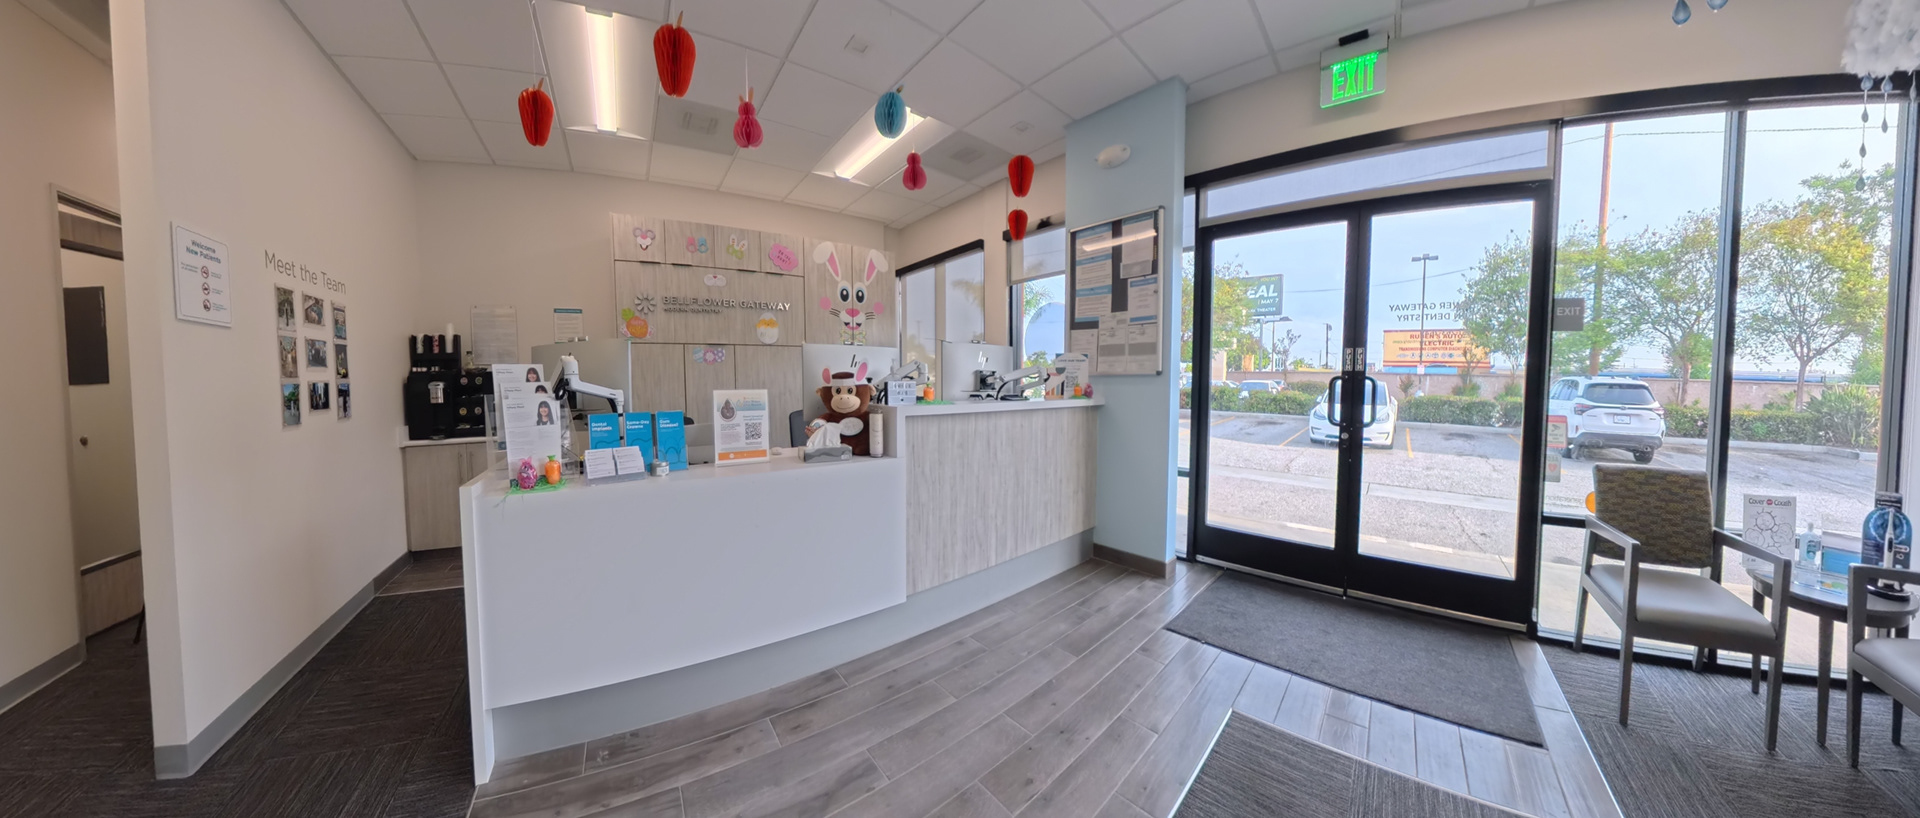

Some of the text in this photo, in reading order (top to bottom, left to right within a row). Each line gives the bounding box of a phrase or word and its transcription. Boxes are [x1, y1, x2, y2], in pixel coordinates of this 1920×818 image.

[1331, 51, 1379, 100] EXIT
[186, 246, 222, 264] New Patients
[191, 240, 216, 254] Welcome
[264, 249, 346, 295] Meet the Team
[662, 296, 791, 311] BELLFLOWER GATEWAY
[1556, 307, 1581, 316] EXIT
[978, 351, 988, 368] hp
[1748, 497, 1766, 505] Cover
[1773, 499, 1792, 507] Cough
